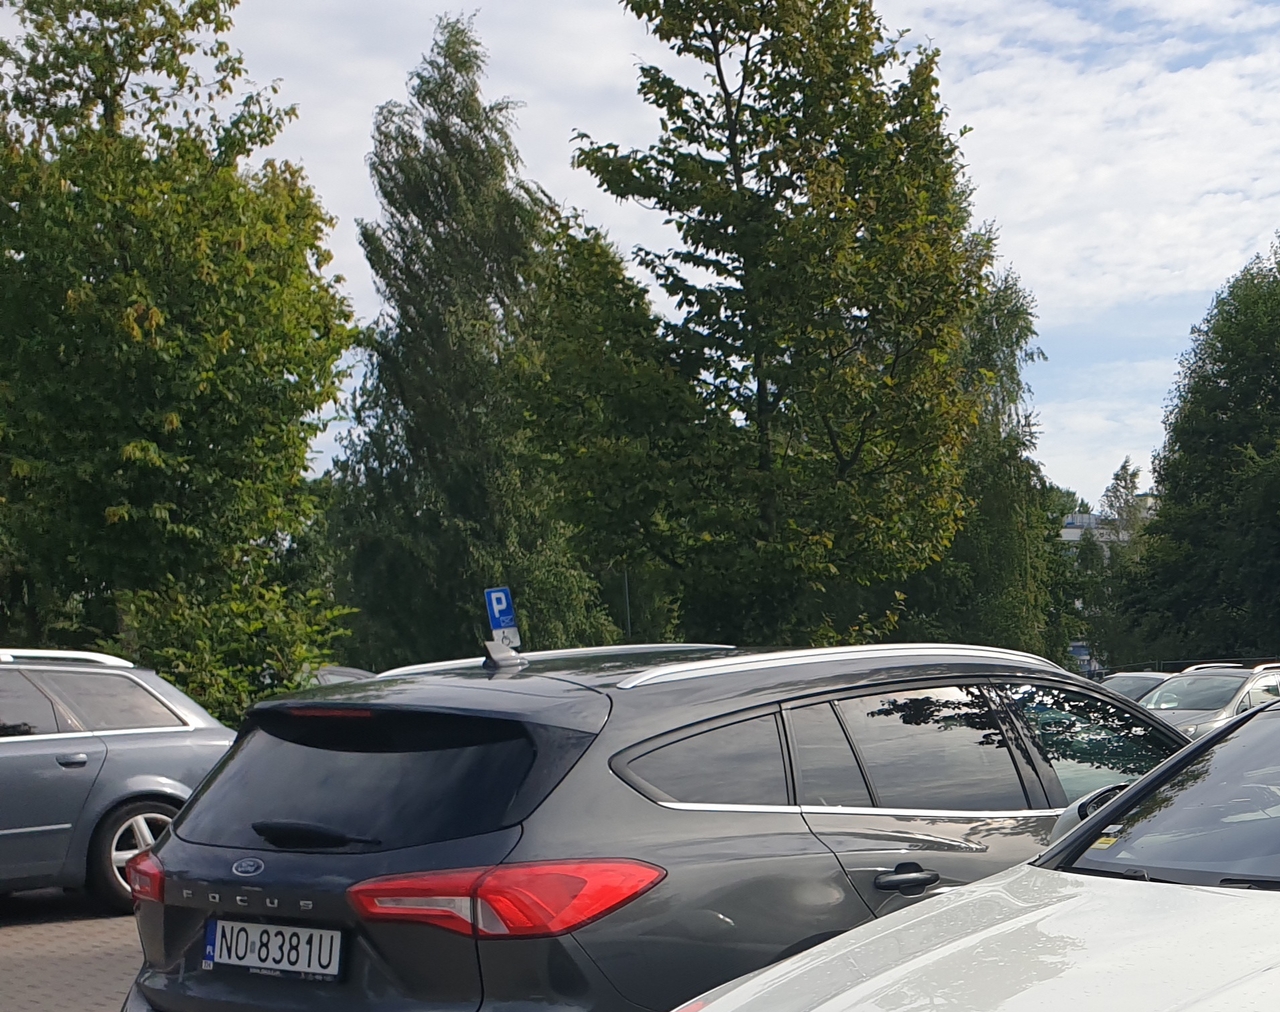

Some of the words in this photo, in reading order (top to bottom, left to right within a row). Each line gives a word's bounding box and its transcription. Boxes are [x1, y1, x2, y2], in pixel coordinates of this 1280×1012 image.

[491, 592, 507, 618] P
[183, 889, 313, 910] FOCUS
[219, 925, 249, 961] NO
[257, 929, 334, 970] 8381U
